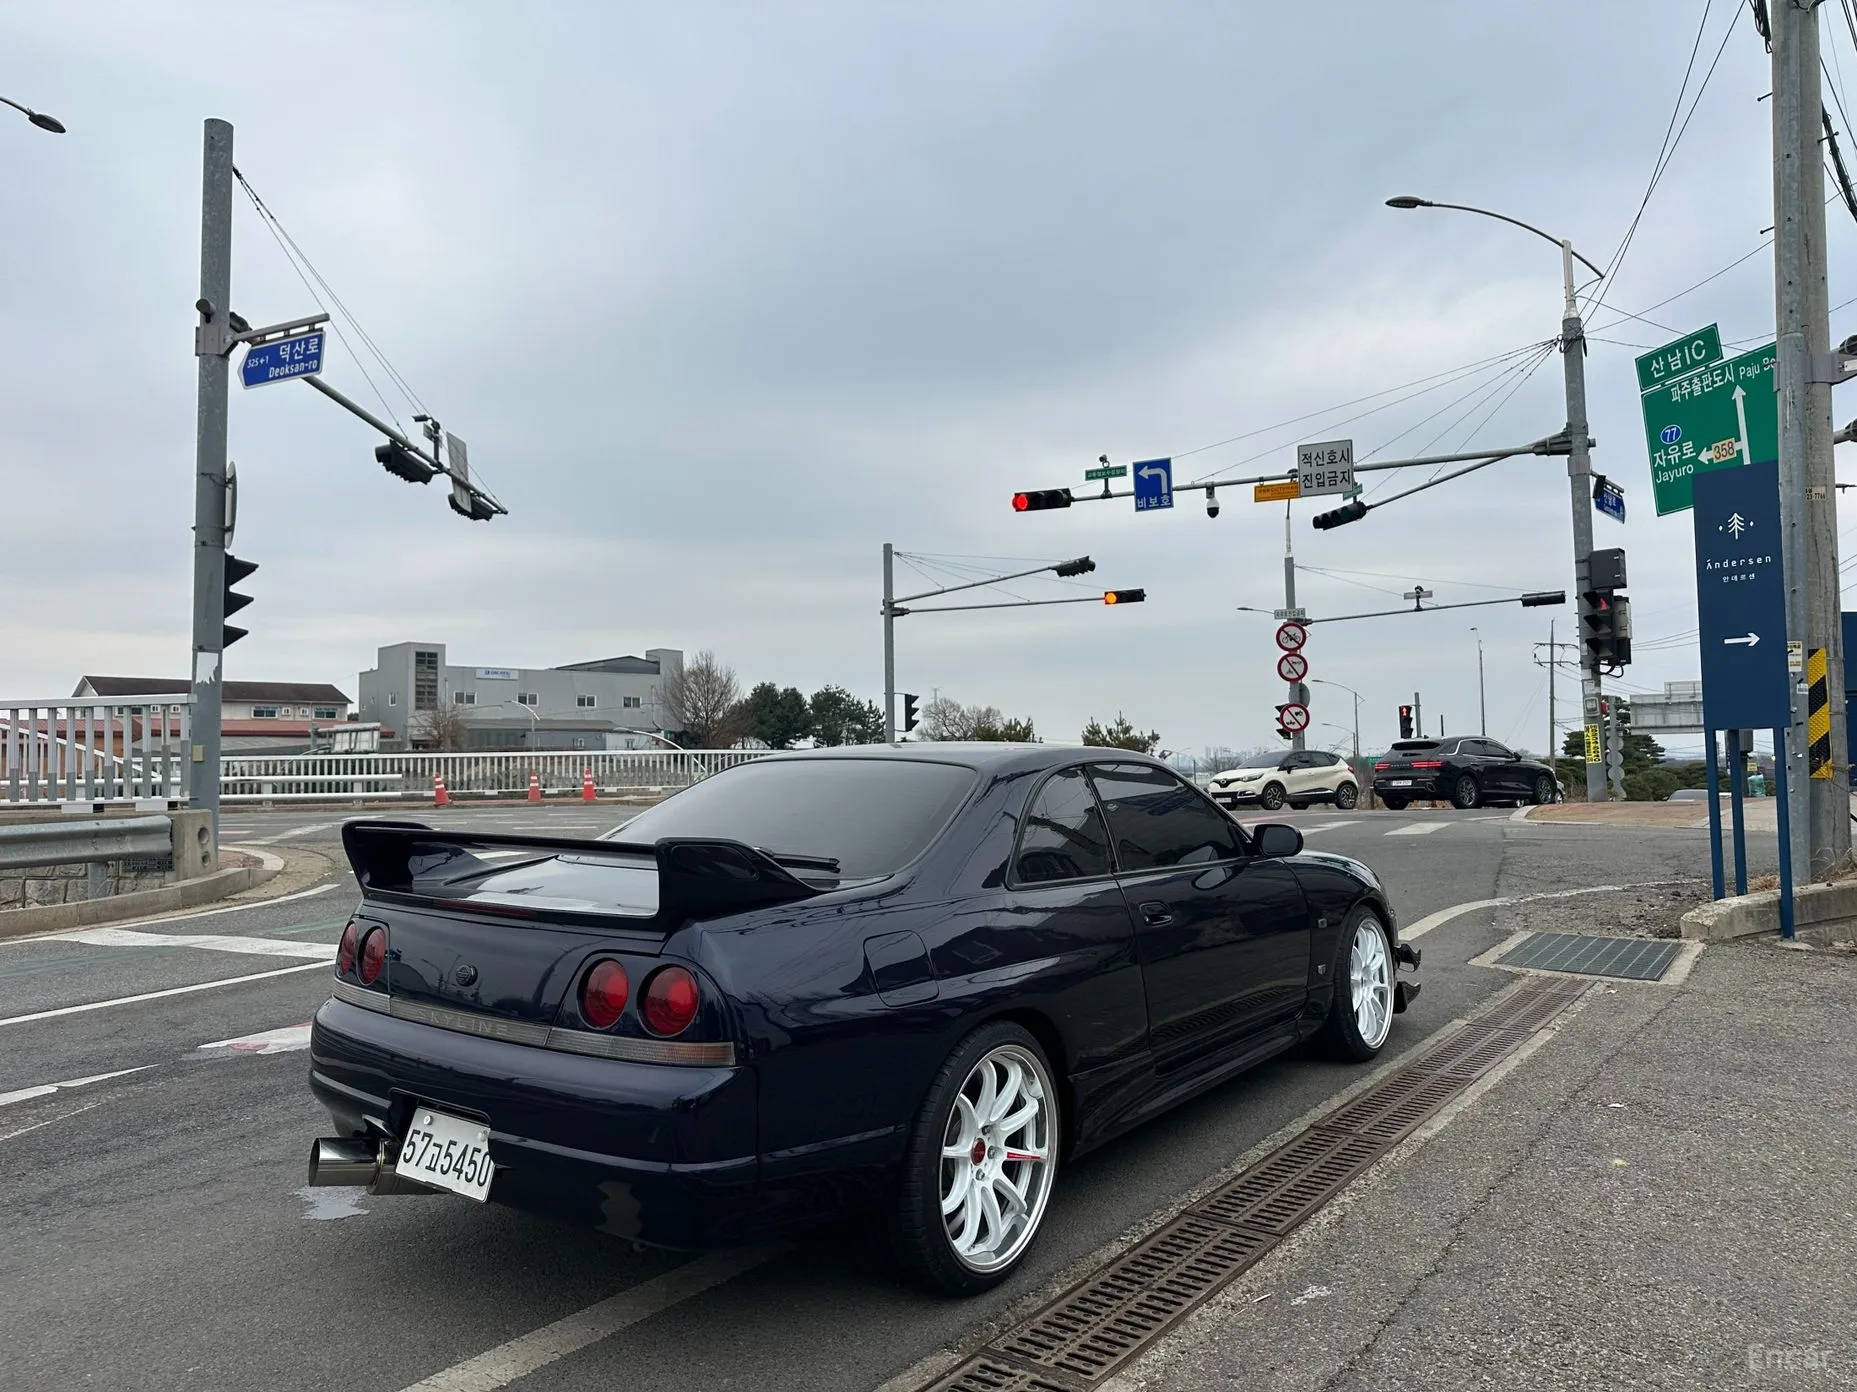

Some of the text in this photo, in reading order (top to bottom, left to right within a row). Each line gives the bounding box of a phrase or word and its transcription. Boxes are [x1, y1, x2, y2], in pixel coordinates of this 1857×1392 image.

[279, 338, 319, 362] 덕산로
[269, 359, 318, 377] Deoksan-ro
[1671, 364, 1734, 402] 파주출판도시
[1739, 362, 1760, 380] Paju
[1664, 427, 1678, 442] 77
[1301, 447, 1350, 468] 적신호시
[1653, 440, 1696, 468] 자유로
[1713, 441, 1735, 460] 358
[1302, 468, 1351, 489] 진입금지
[1655, 463, 1694, 483] Jayuro
[1137, 494, 1171, 508] 비보호
[417, 1008, 509, 1035] SKYLINE
[403, 1128, 491, 1187] 57고5450
